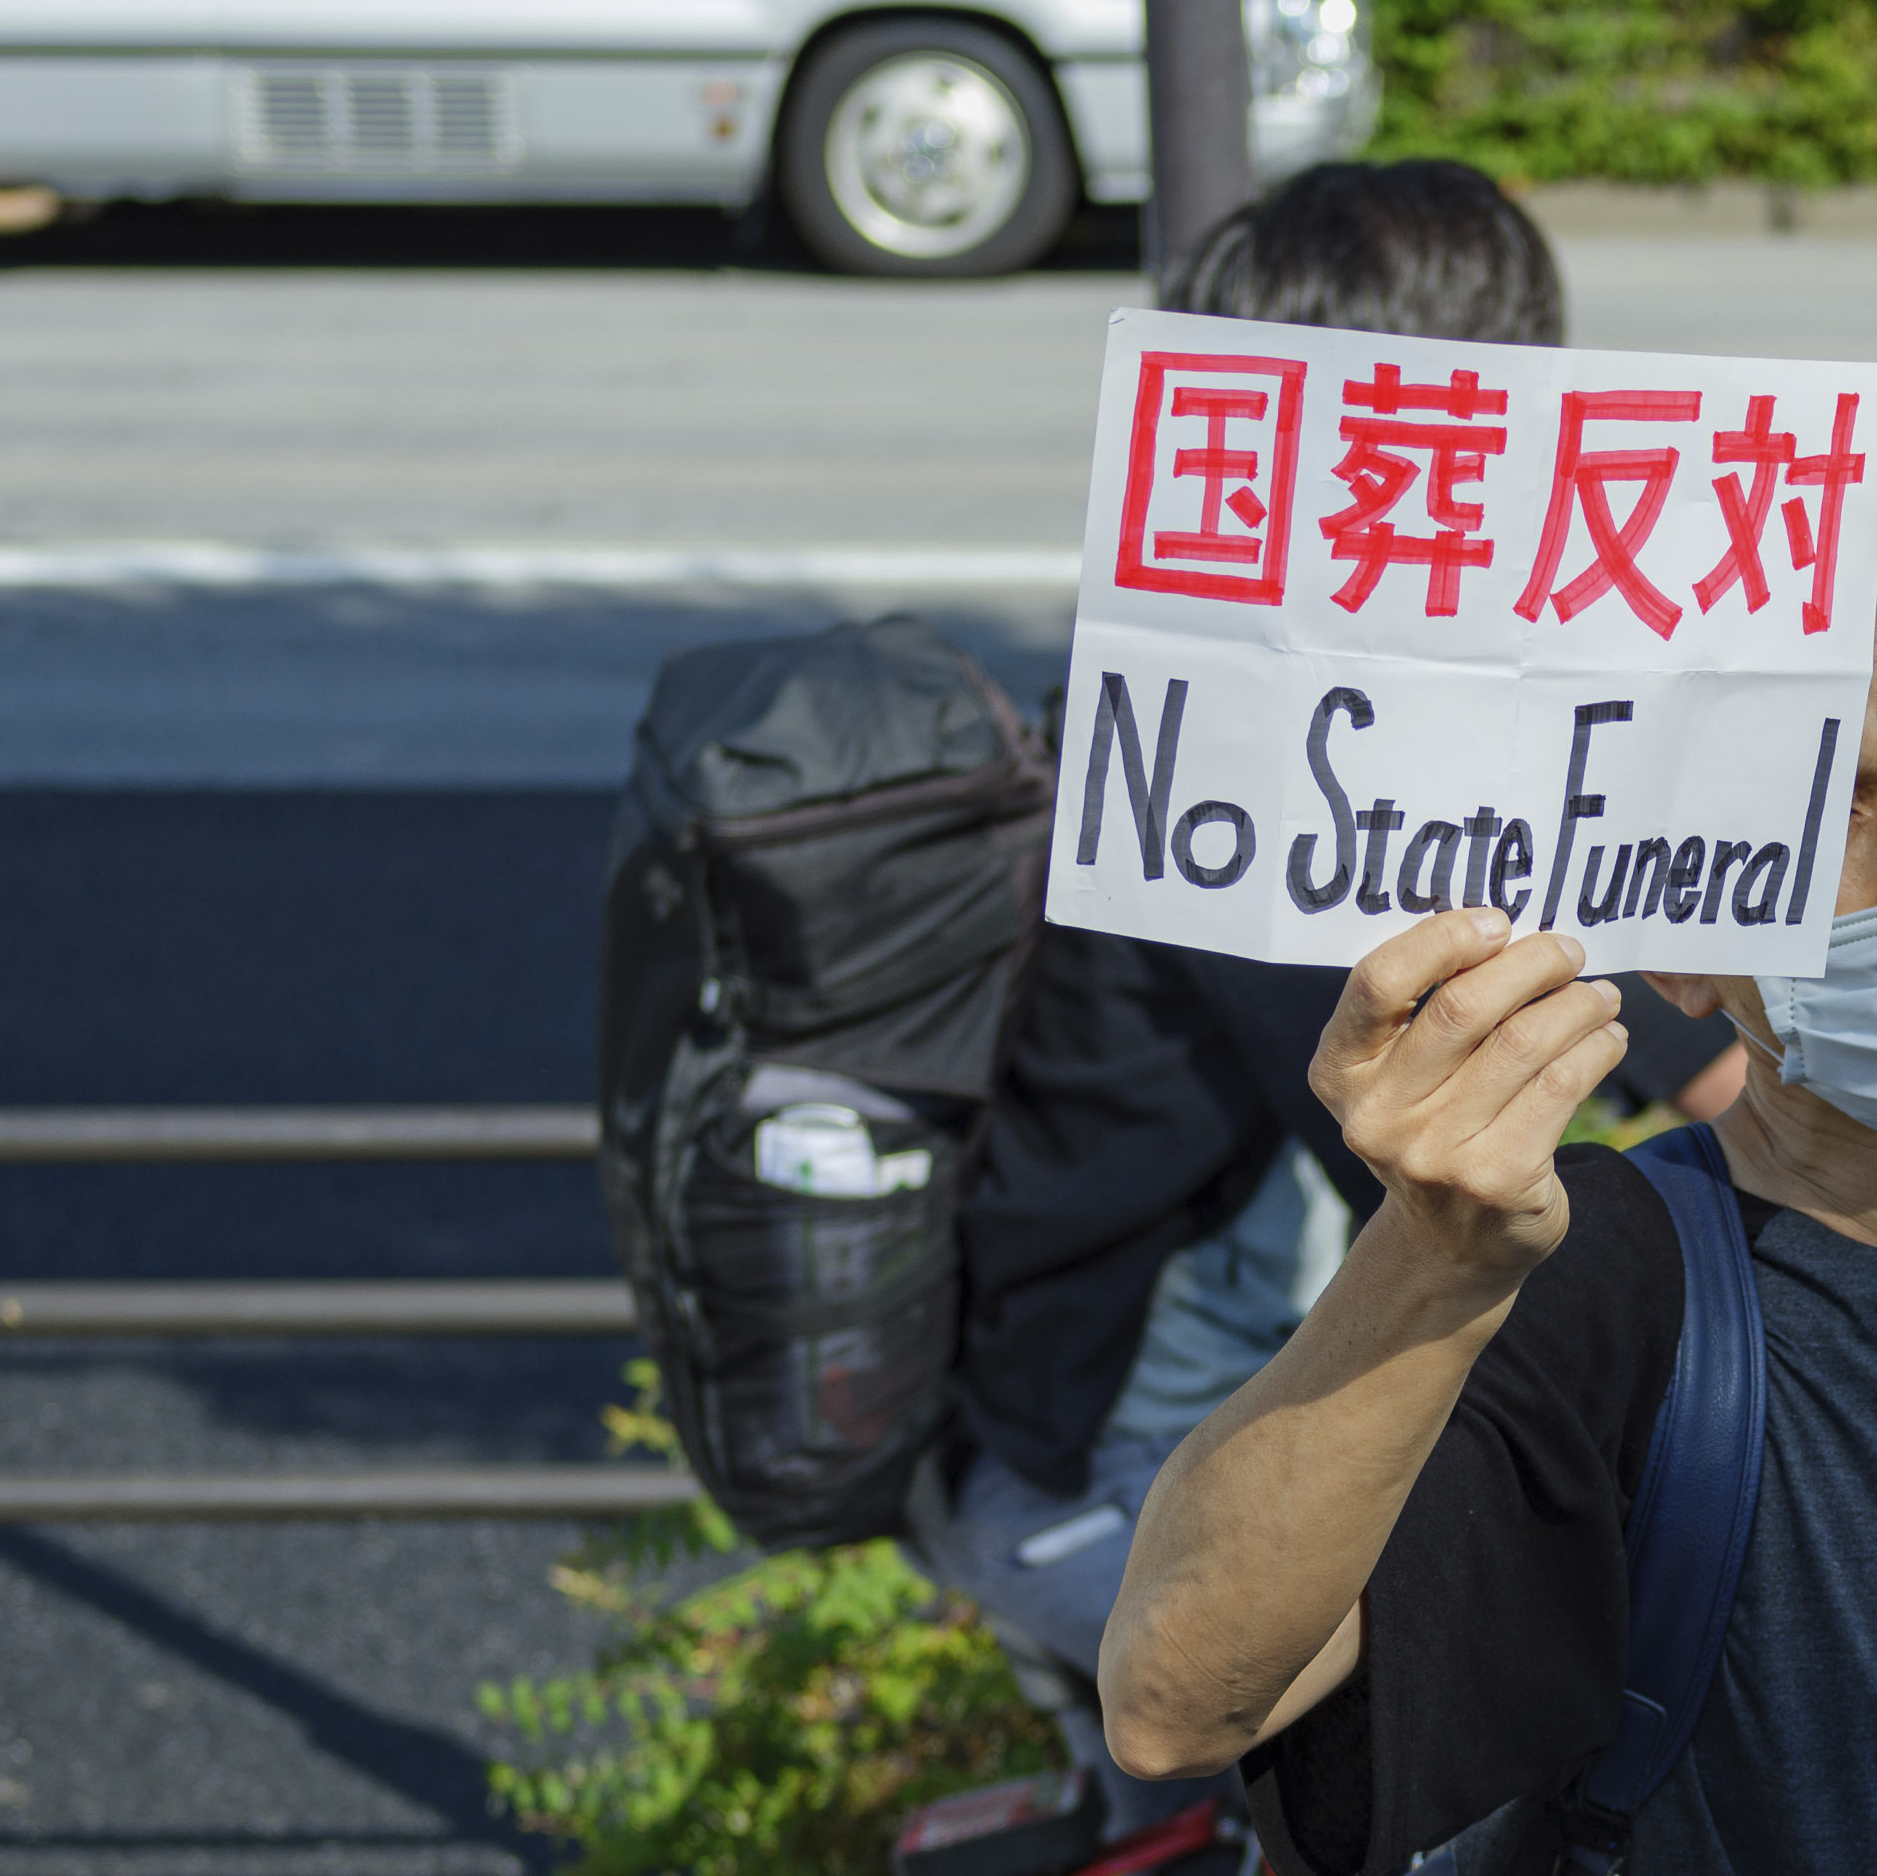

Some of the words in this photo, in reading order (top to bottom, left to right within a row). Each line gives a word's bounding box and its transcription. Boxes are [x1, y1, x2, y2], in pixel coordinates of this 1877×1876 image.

[1113, 350, 1866, 642] 国葬反対
[1076, 671, 1257, 890] No
[1285, 685, 1534, 923] State
[1538, 699, 1842, 931] Funeral
